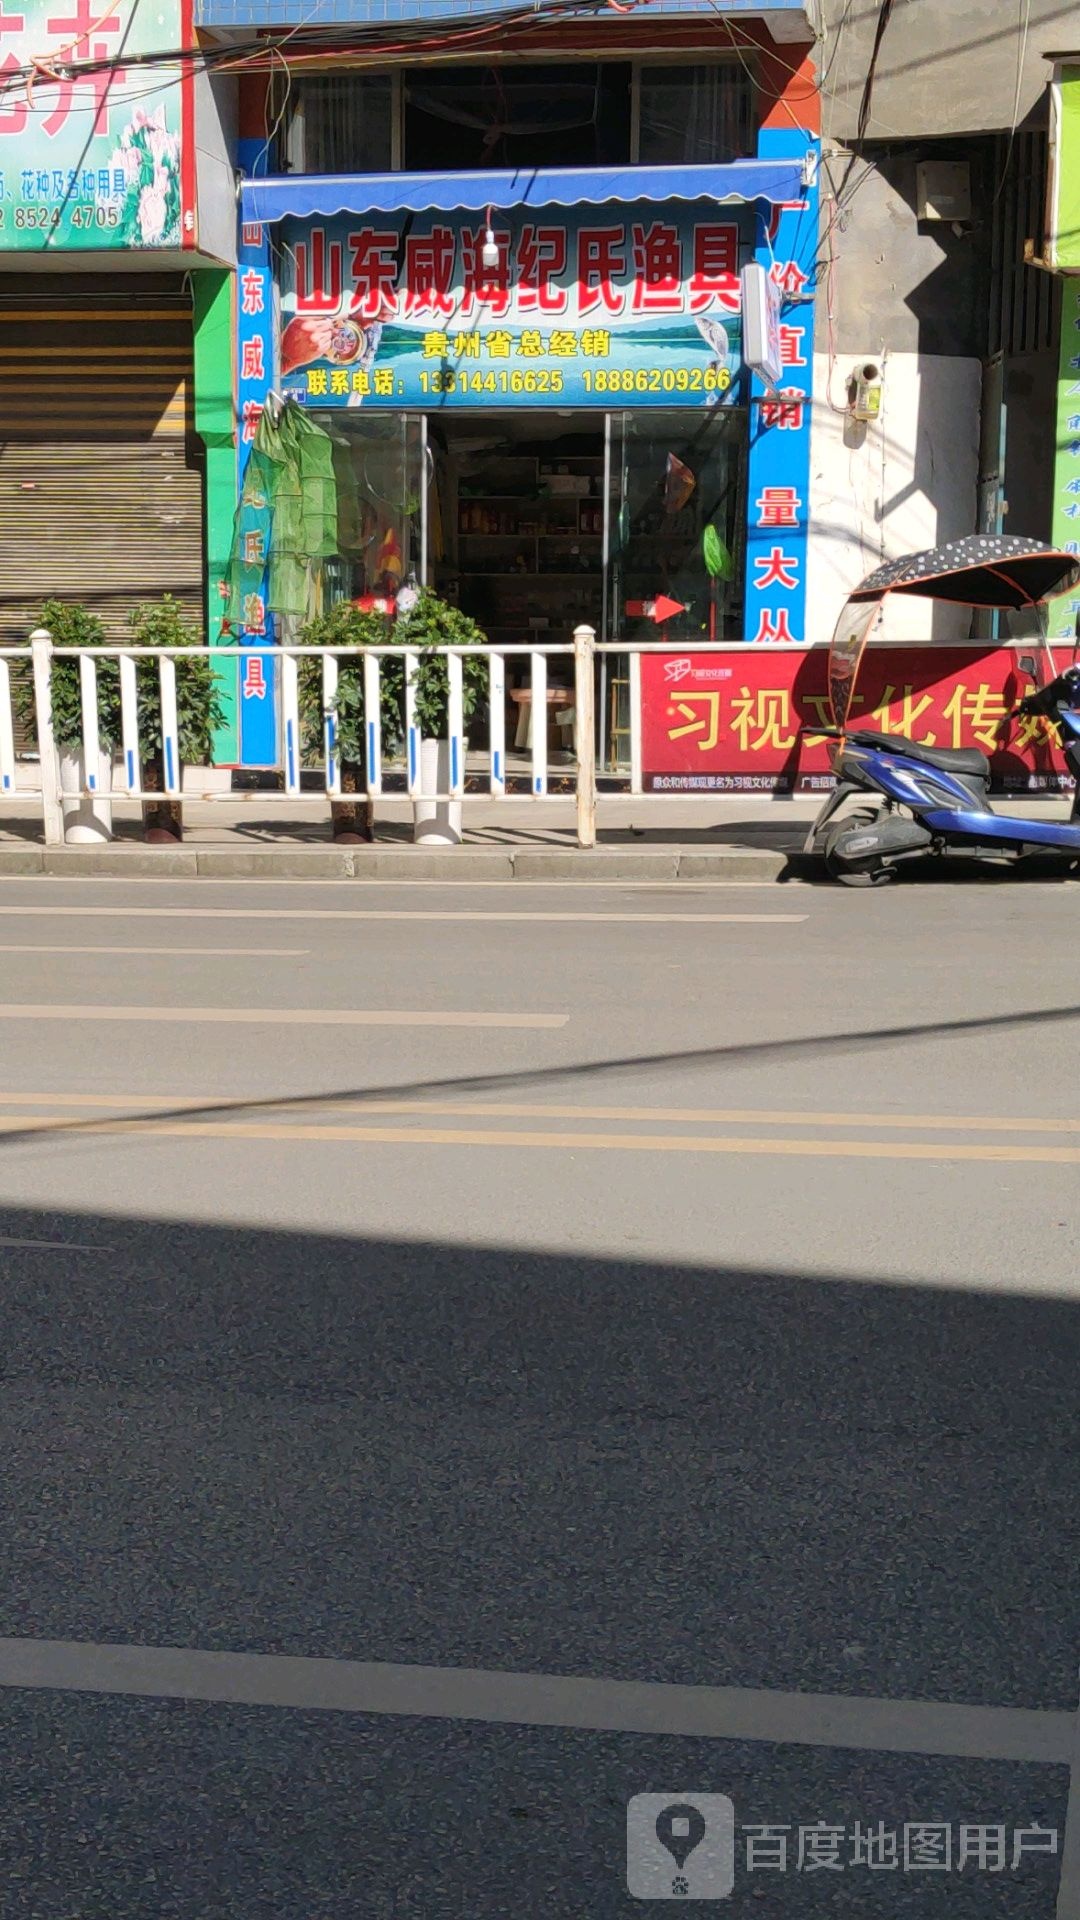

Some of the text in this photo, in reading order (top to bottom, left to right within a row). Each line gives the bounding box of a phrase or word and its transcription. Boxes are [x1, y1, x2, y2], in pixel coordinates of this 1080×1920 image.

[15, 207, 61, 229] 8524
[72, 206, 118, 227] 4705
[294, 224, 742, 316] 山东威海纪氏渔具
[421, 331, 611, 358] 贵州省总经销
[307, 370, 404, 396] 联系电话：
[418, 369, 565, 394] 13314416625
[581, 368, 731, 393] 18886209266
